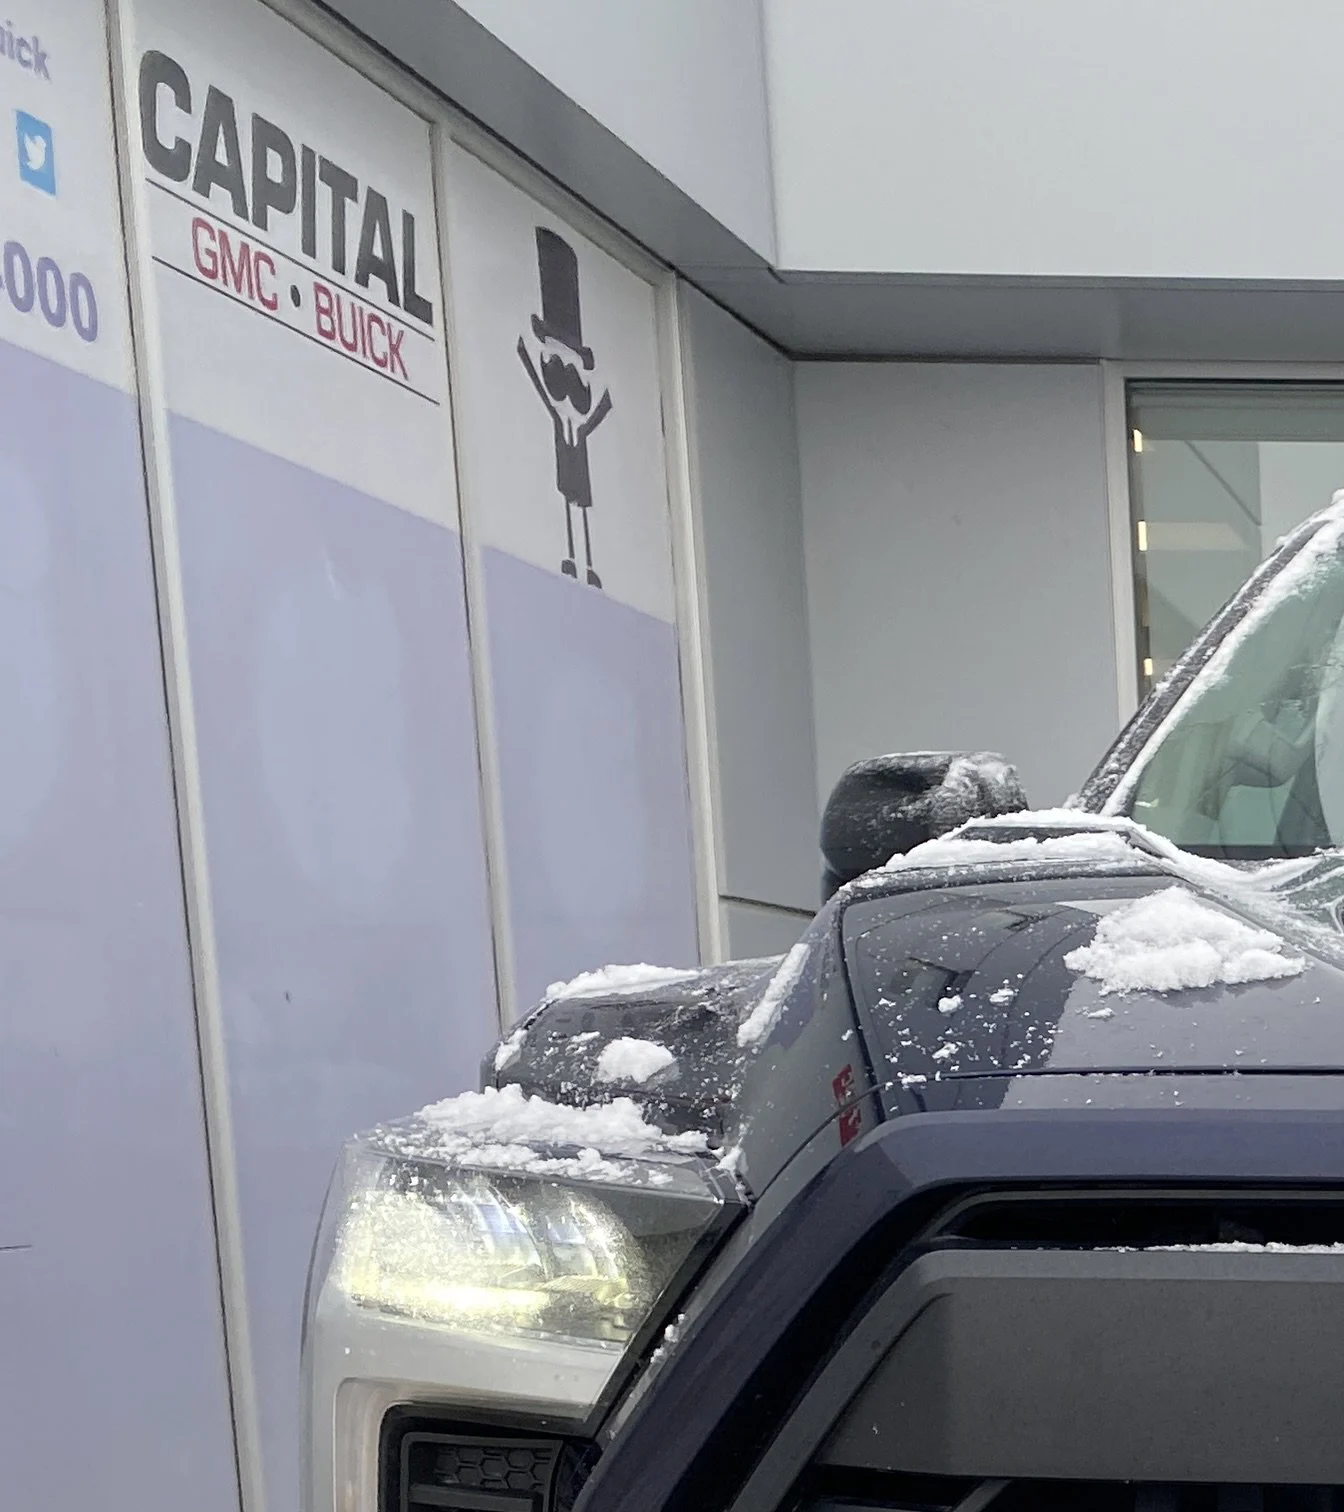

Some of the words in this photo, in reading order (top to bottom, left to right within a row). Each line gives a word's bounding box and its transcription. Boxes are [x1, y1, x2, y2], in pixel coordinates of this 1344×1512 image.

[138, 50, 434, 327] CAPITAL
[0, 240, 98, 343] 000
[191, 216, 279, 312] GMC
[313, 281, 409, 381] BUICK
